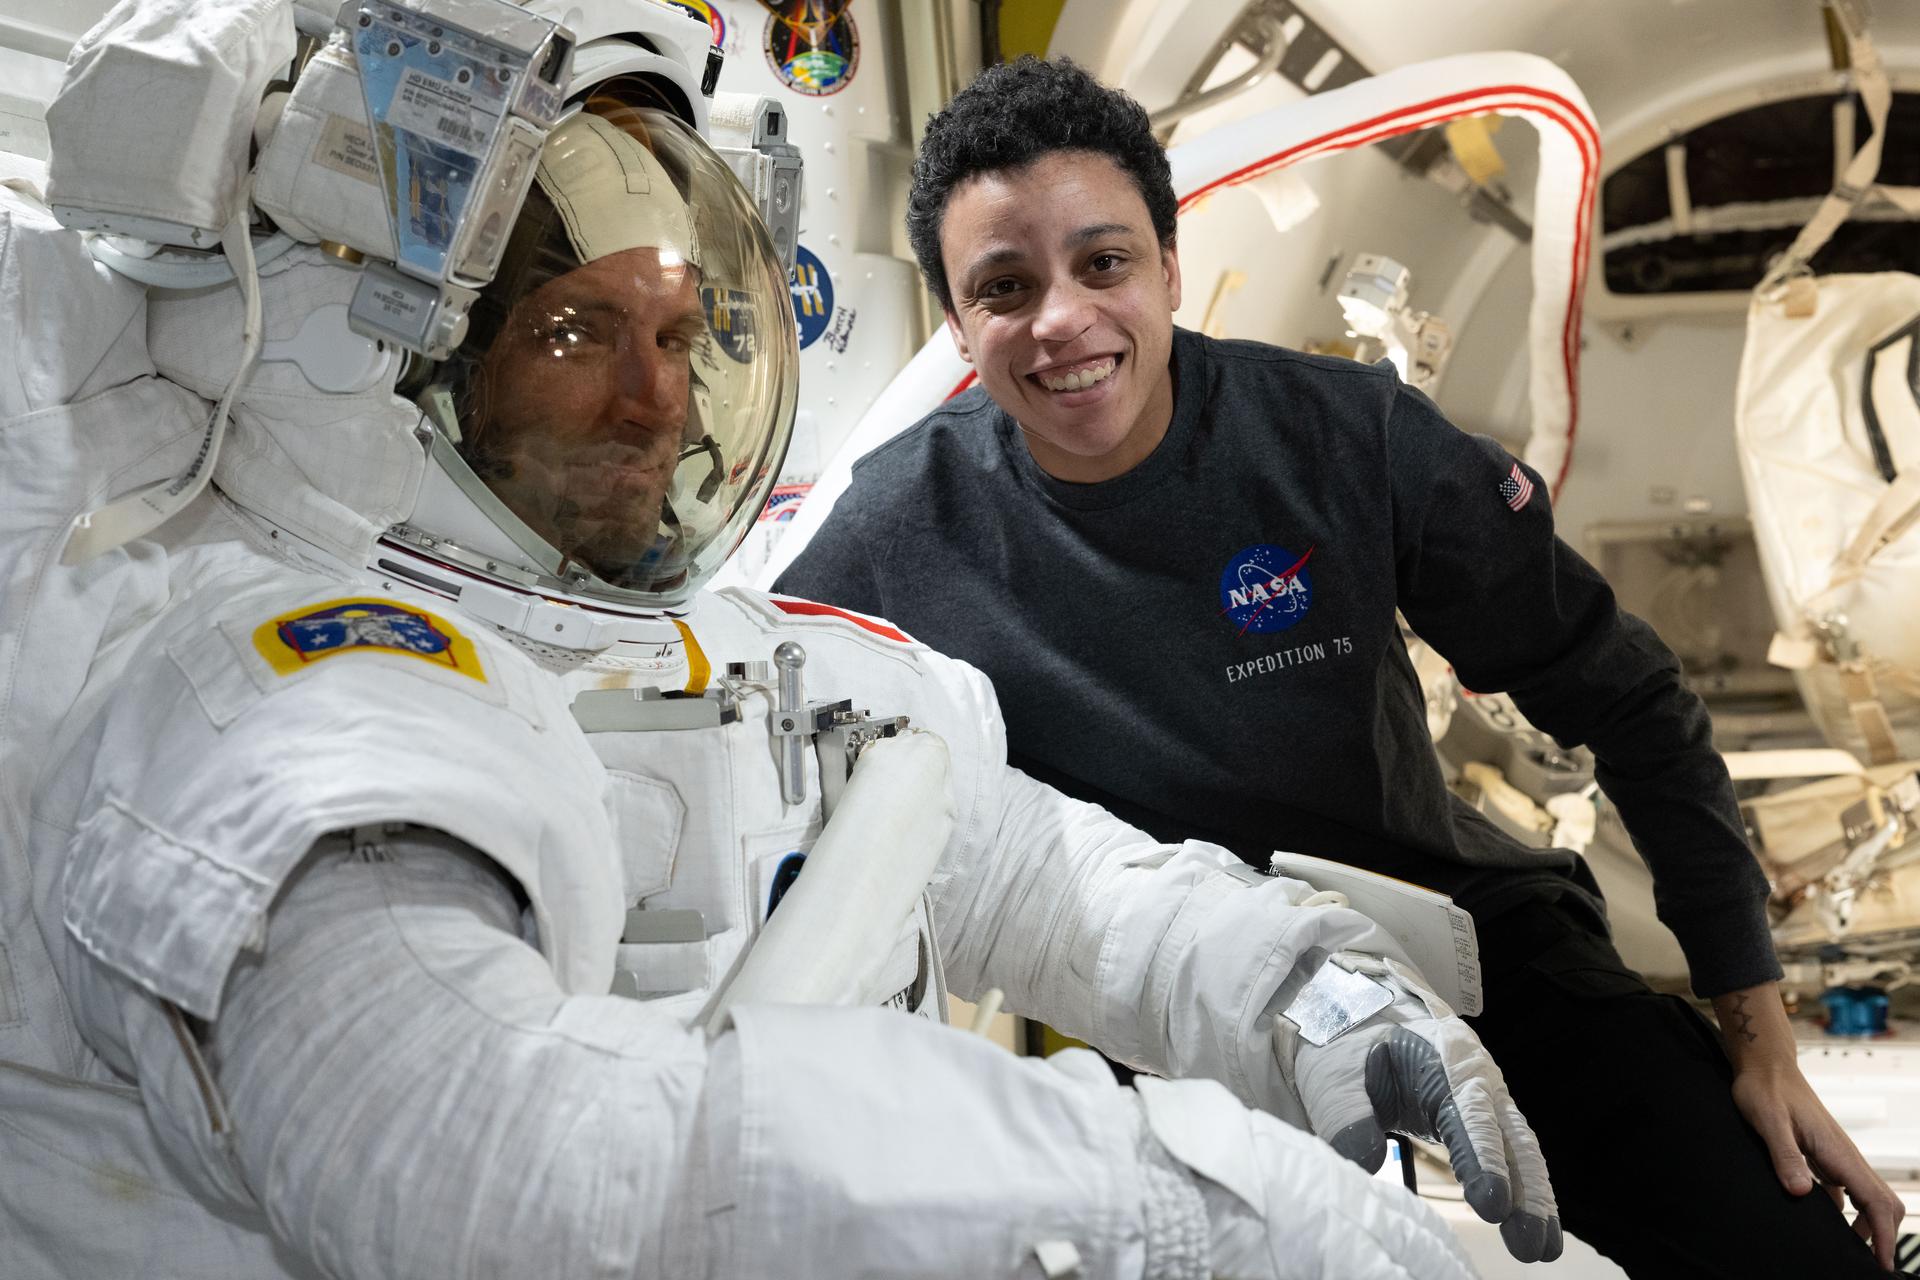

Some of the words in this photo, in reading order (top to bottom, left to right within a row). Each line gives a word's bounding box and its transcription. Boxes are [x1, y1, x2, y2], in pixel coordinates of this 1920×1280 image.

[408, 73, 422, 84] HD
[423, 78, 441, 91] EMU
[442, 85, 472, 103] Camera
[733, 334, 755, 352] 72
[1228, 574, 1307, 609] NASA
[1226, 642, 1325, 683] EXPEDITION
[1333, 637, 1353, 655] 75
